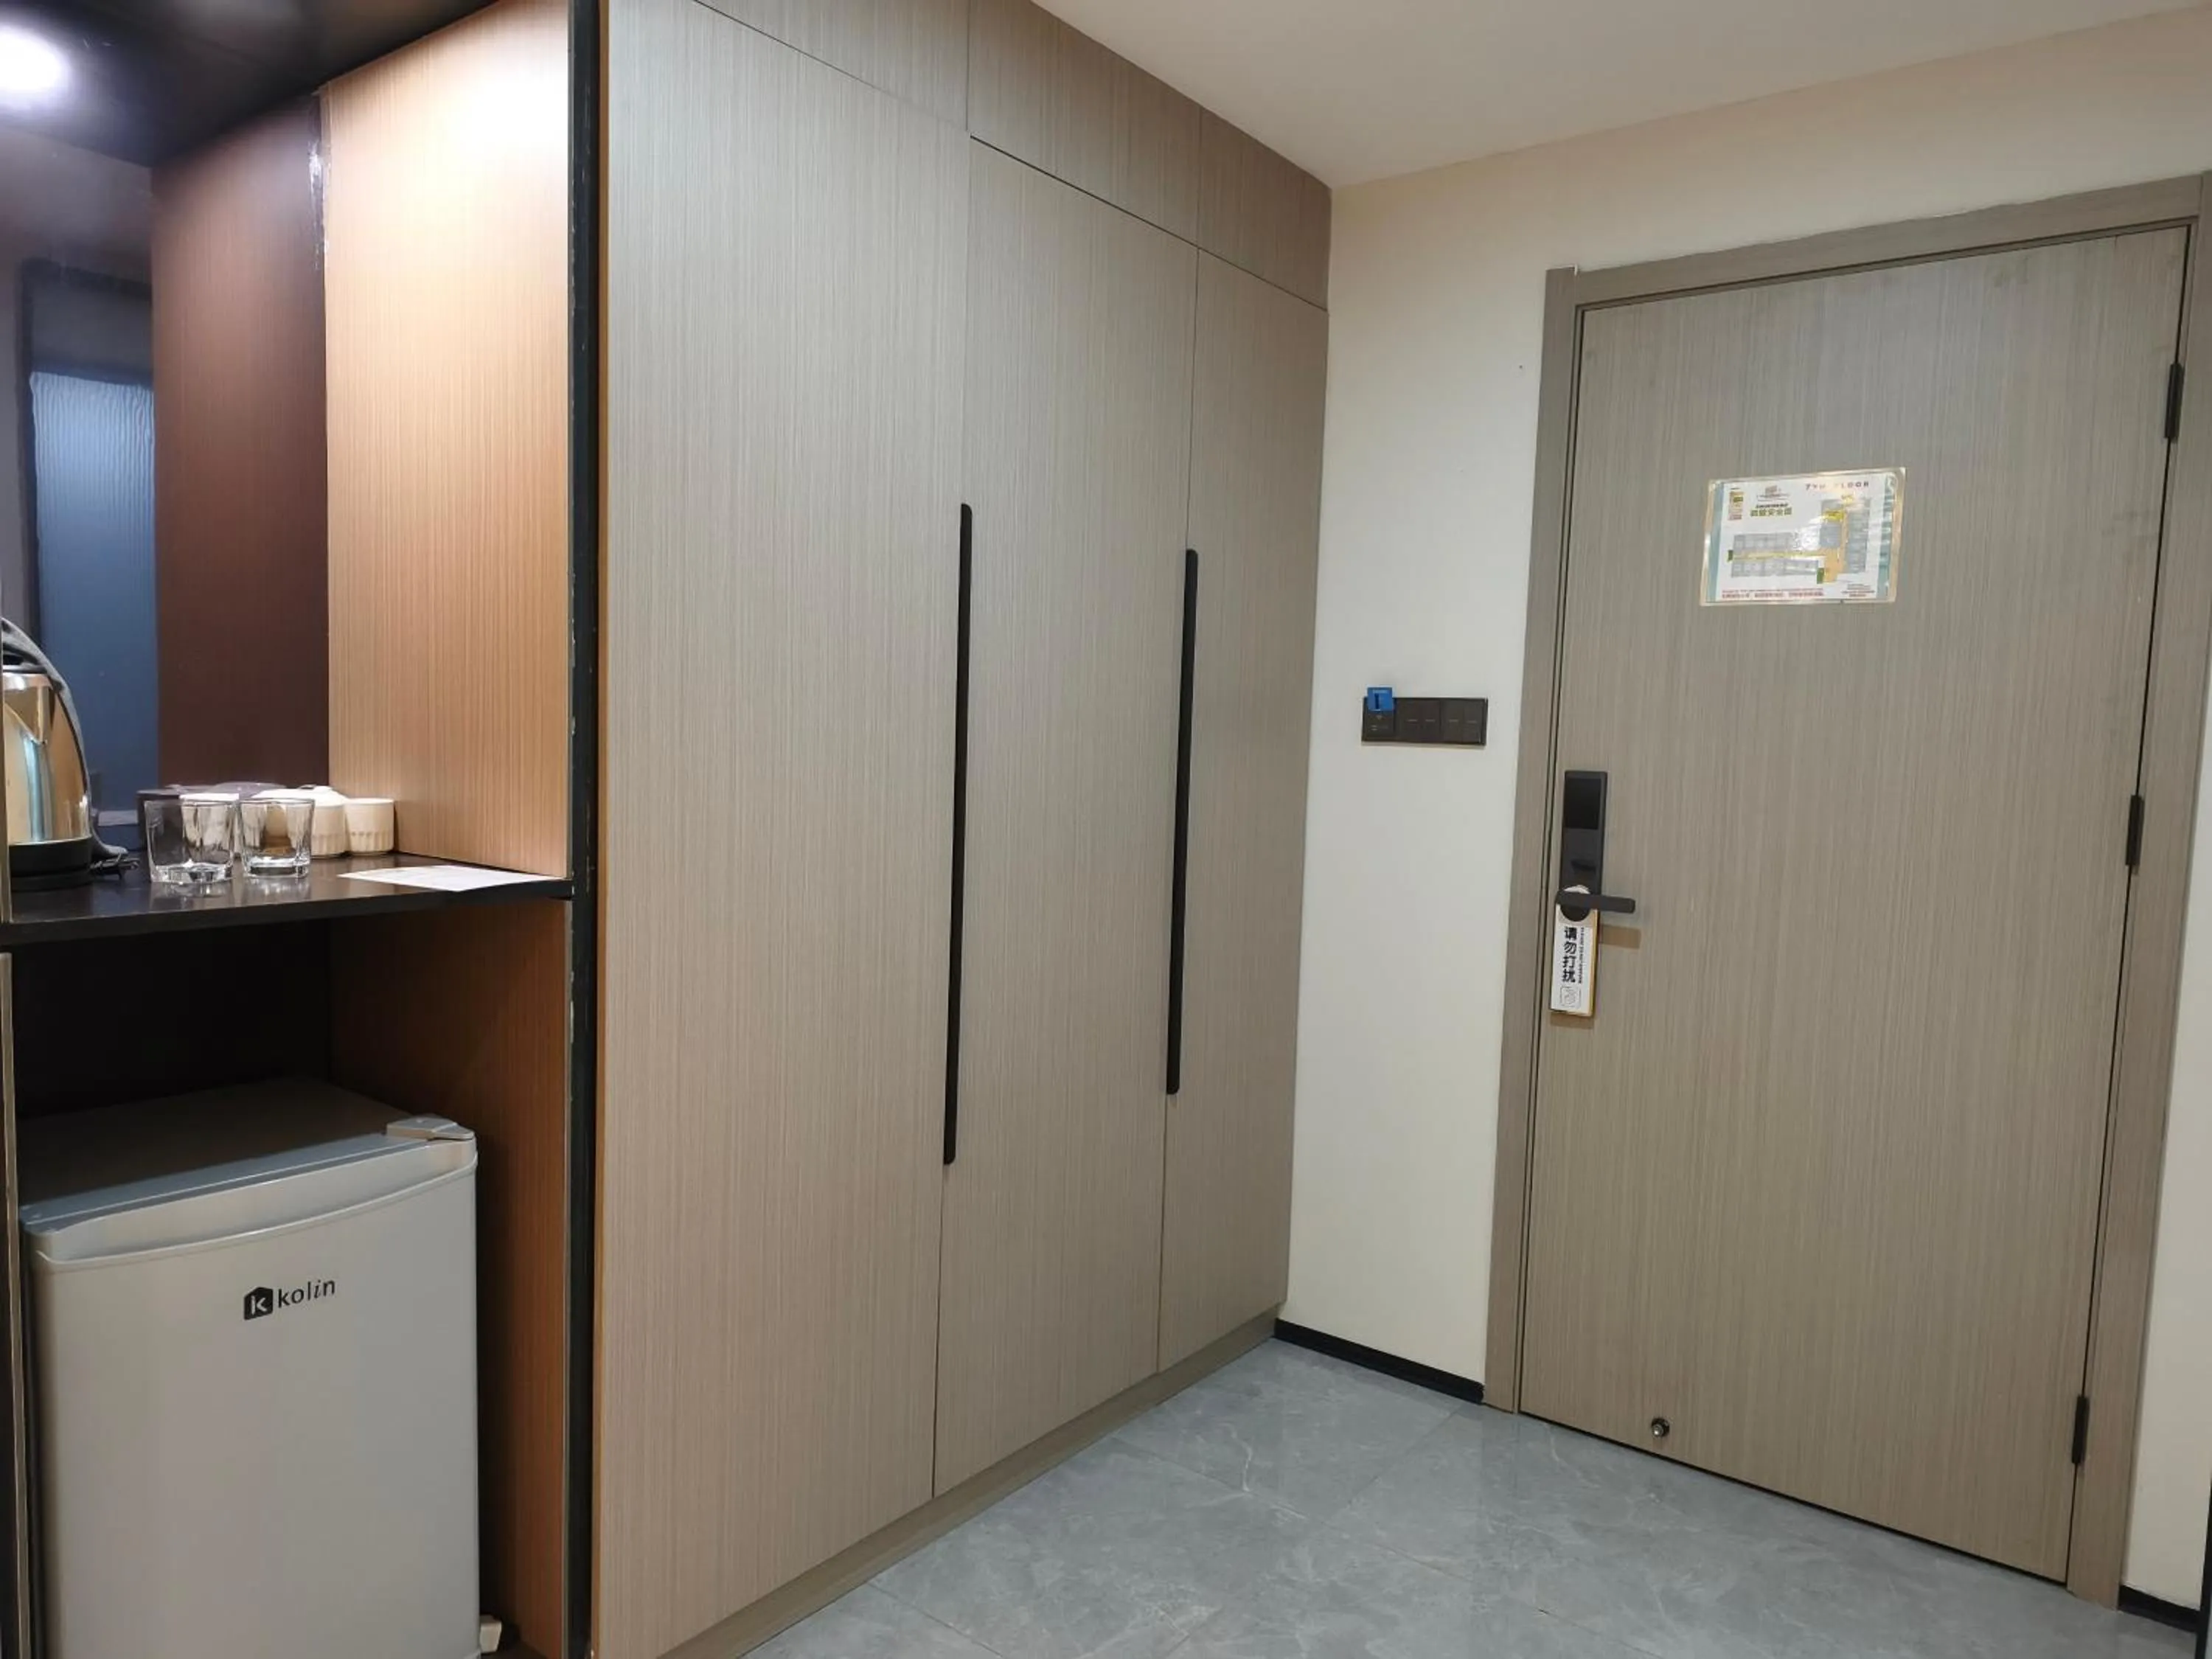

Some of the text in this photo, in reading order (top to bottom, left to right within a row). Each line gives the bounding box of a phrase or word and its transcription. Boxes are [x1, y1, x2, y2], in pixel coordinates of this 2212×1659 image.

[1562, 926, 1577, 983] 请勿打扰
[278, 1279, 335, 1308] kolin
